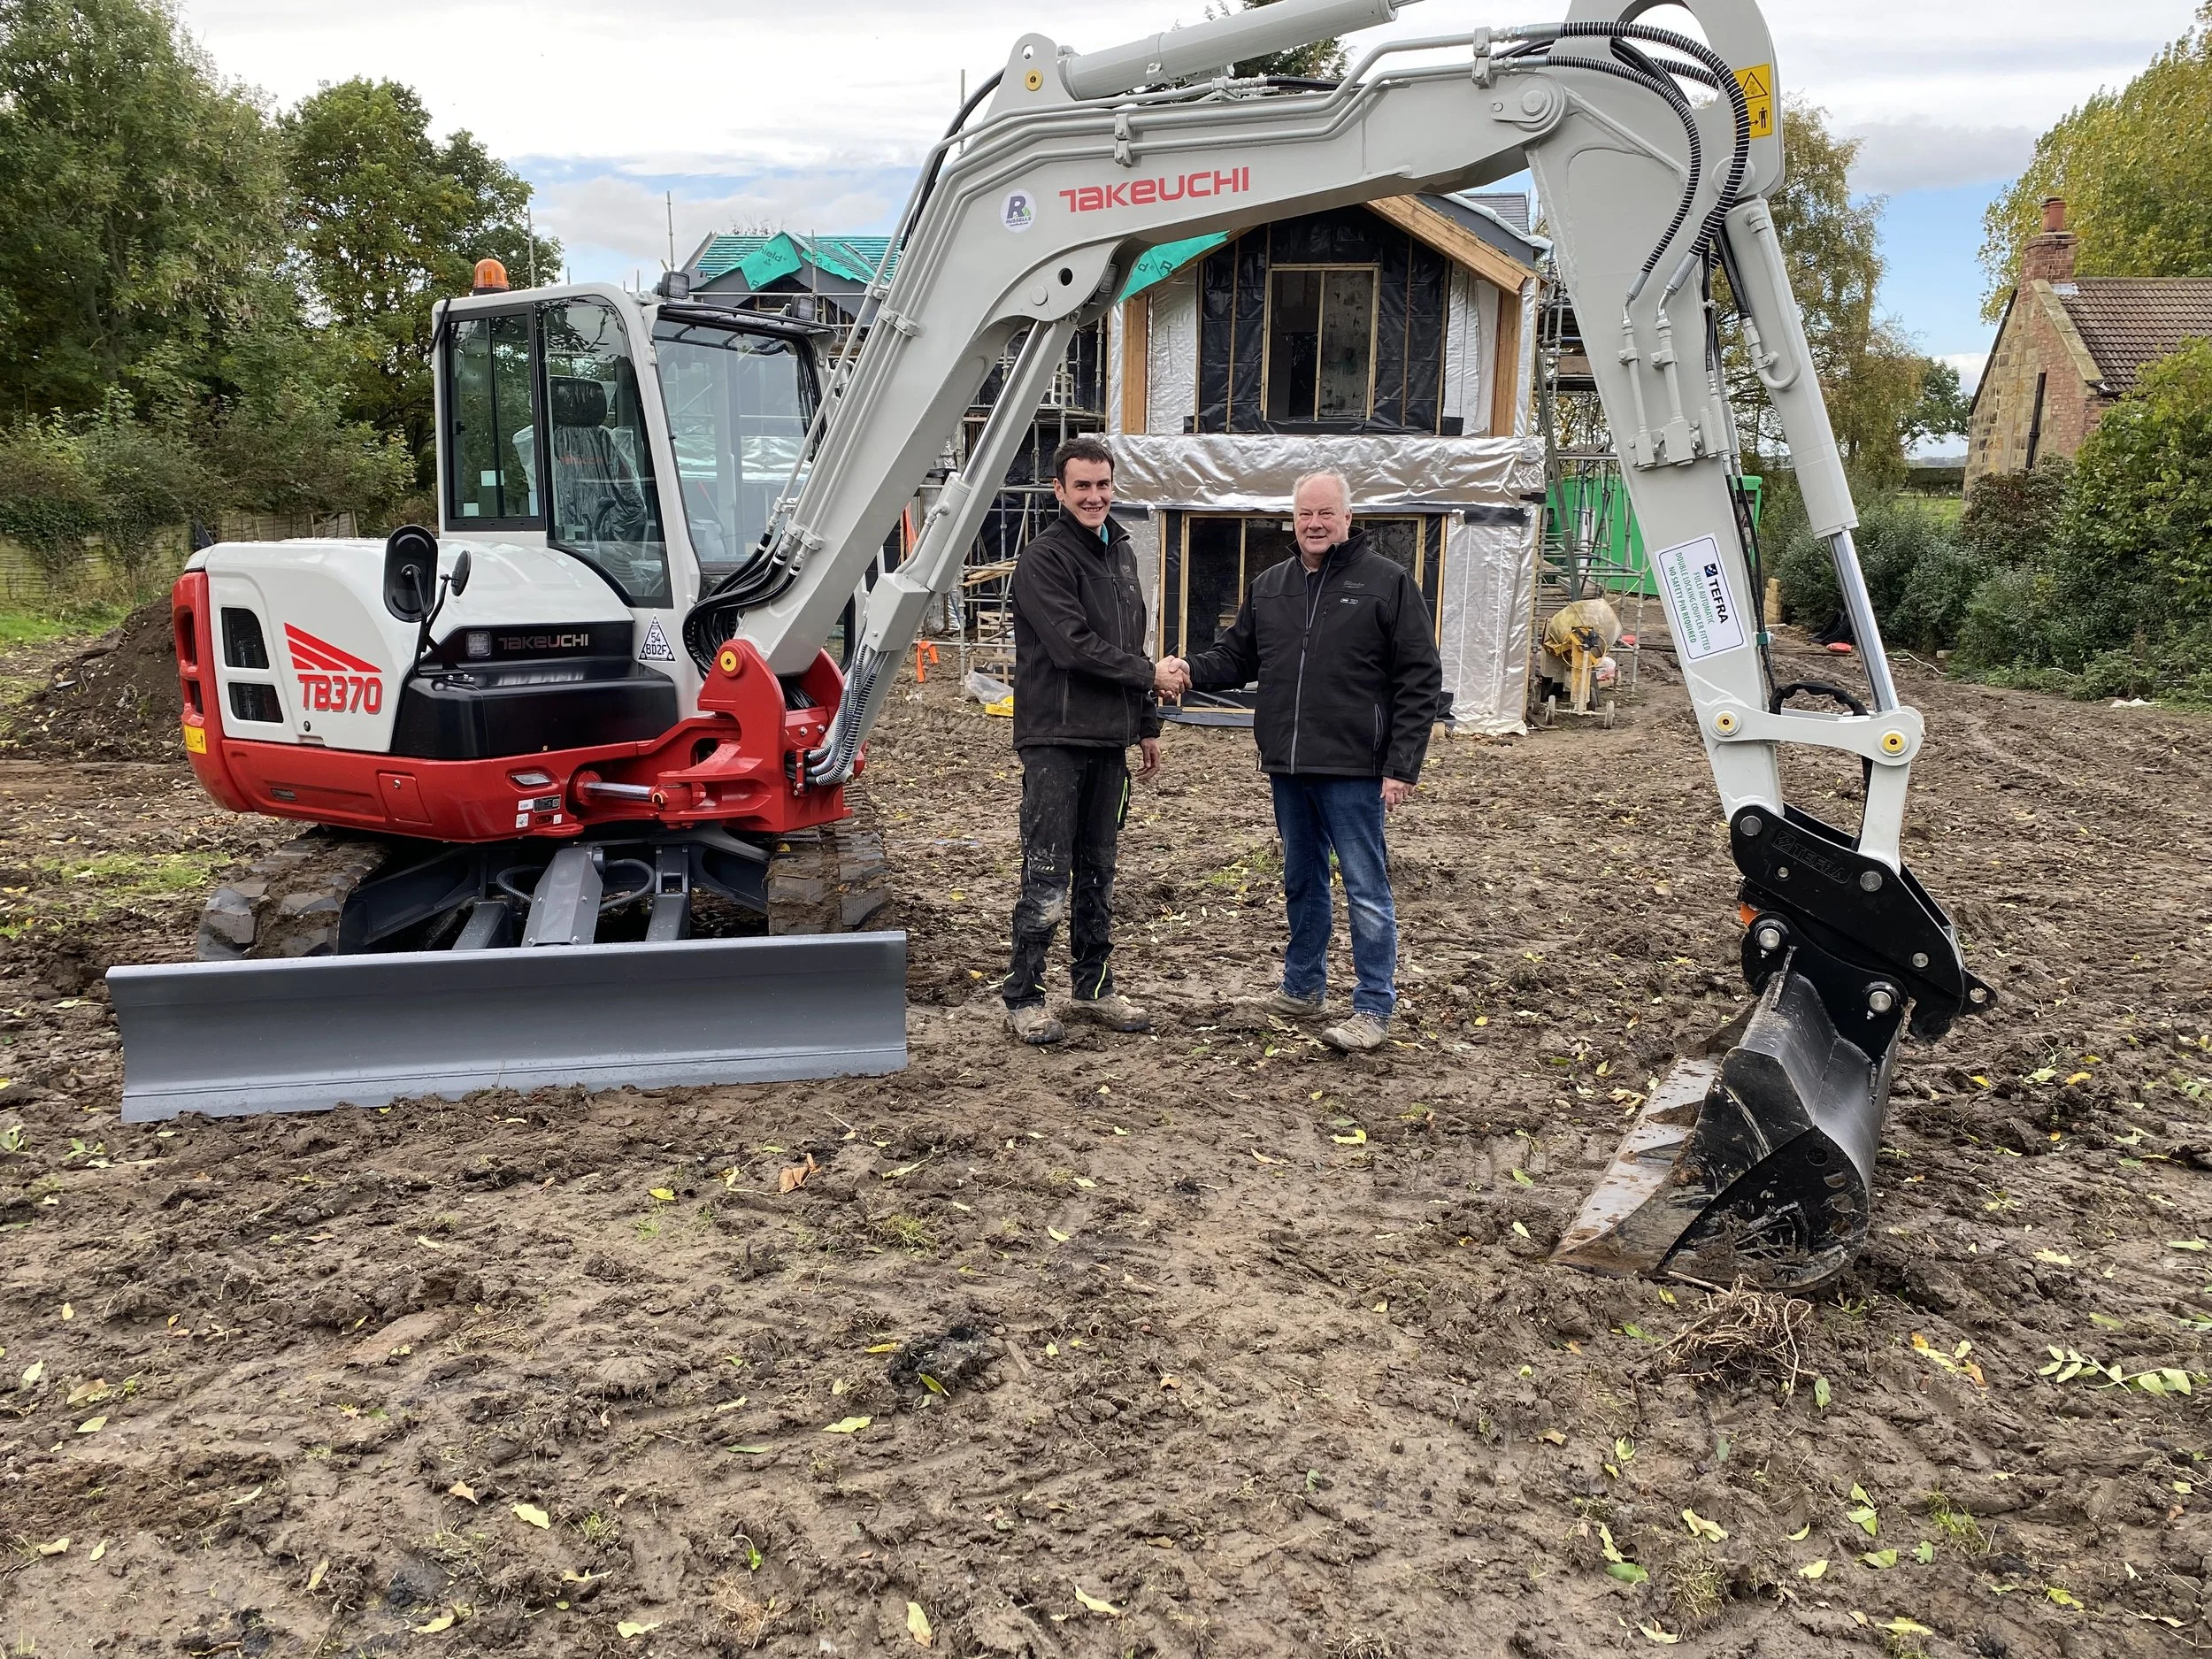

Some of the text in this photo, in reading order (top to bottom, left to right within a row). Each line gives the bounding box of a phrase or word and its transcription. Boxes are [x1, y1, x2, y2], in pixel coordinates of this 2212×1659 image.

[1059, 166, 1249, 212] TAKEUCHI
[1668, 566, 1697, 643] NO SAFETY PIN REQUIRED
[1676, 552, 1711, 651] DOUBLE LOCKING COUPLER FITTED
[1694, 572, 1715, 625] FULLY AUTOMATIC
[1709, 578, 1728, 624] TEFRA
[498, 634, 588, 650] TAKEUCHI
[651, 632, 661, 644] 54
[297, 674, 382, 715] TB370
